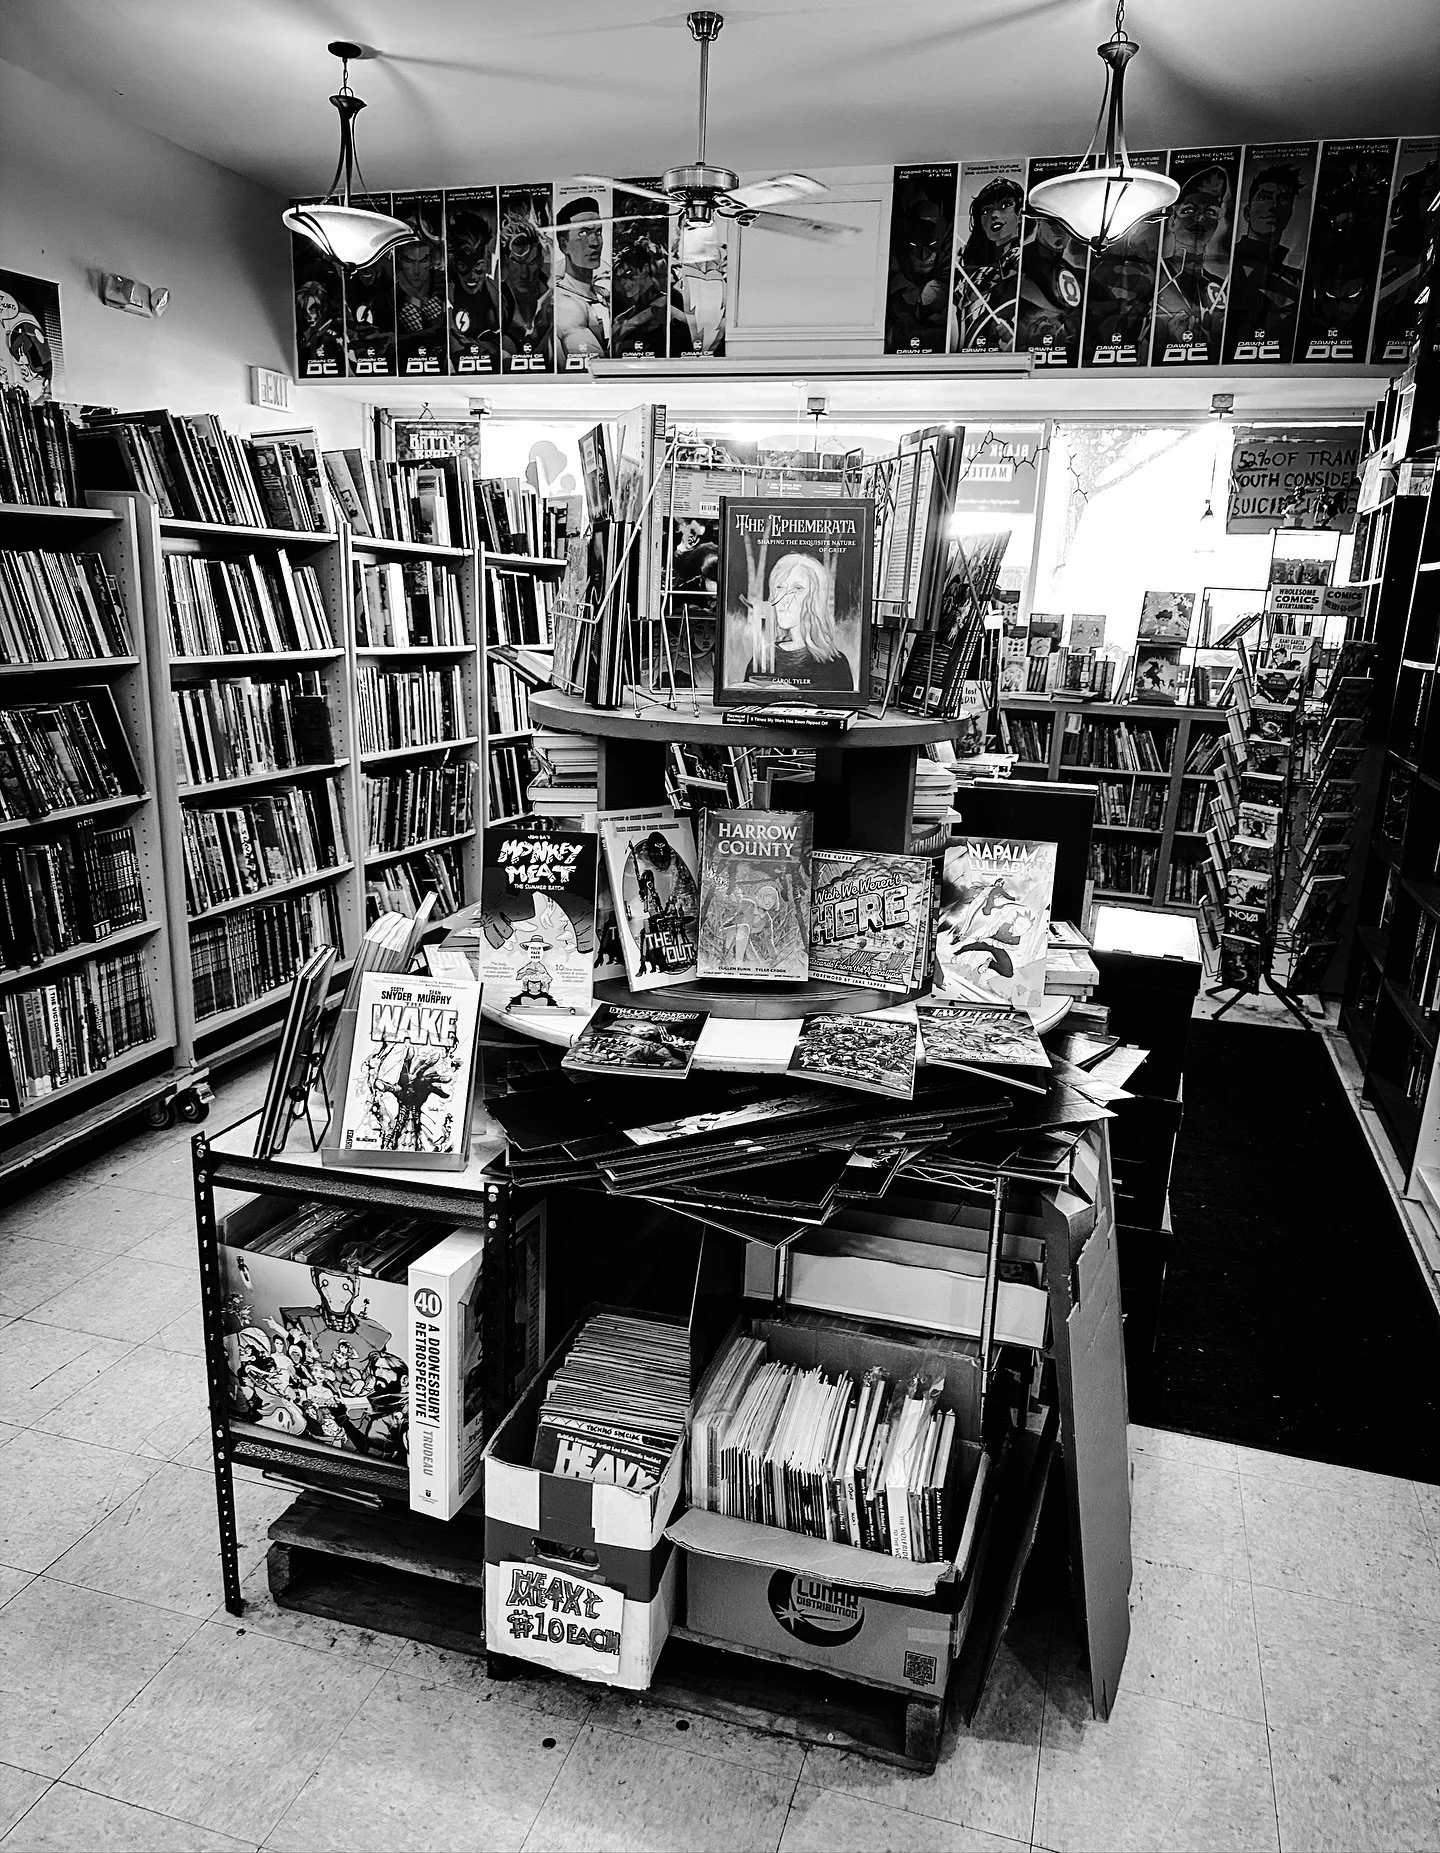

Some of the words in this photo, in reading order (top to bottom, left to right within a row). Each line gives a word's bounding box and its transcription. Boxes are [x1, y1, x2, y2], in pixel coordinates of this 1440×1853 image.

[1092, 350, 1137, 364] DC
[1162, 348, 1208, 362] DC
[1233, 345, 1281, 360] DC
[1305, 344, 1354, 359] DC
[1382, 346, 1412, 359] D
[306, 363, 339, 375] DC
[356, 362, 389, 374] DC
[406, 361, 440, 373] DC
[458, 360, 493, 372] DC
[510, 358, 546, 370] DC
[565, 357, 589, 370] D
[262, 374, 289, 408] EXIT
[654, 404, 666, 440] BOOM!
[1238, 448, 1271, 468] 52%
[1272, 451, 1299, 466] OF
[1306, 450, 1360, 467] TRAN
[1236, 474, 1280, 488] YOUTH
[736, 514, 765, 536] THE
[768, 514, 857, 537] EPHEMERATA
[757, 538, 784, 546] SHAPING
[785, 538, 798, 546] THE
[798, 539, 830, 547] EXQUISITE
[1274, 596, 1320, 604] COMICS
[1279, 588, 1317, 596] WHOLESOME
[1326, 590, 1363, 600] COMICS
[718, 822, 798, 841] HARROW
[497, 838, 584, 864] MONKEY
[718, 840, 795, 858] COUNTY
[966, 840, 1040, 864] NAPALM
[504, 862, 577, 884] MEAT
[967, 859, 1032, 874] LULLABY
[814, 888, 840, 905] Wish
[840, 882, 858, 898] We
[859, 873, 902, 894] Weren't
[810, 886, 910, 944] HERE
[1228, 909, 1258, 922] NOVA
[644, 931, 673, 950] THE
[812, 972, 842, 981] FOREWORD
[834, 960, 853, 970] from
[853, 965, 864, 973] the
[864, 966, 903, 979] Apocalypse
[381, 990, 412, 1002] SNYDER
[416, 993, 452, 1005] MURPHY
[370, 1004, 459, 1048] WAKE
[416, 1290, 440, 1315] 40
[428, 1324, 440, 1332] A
[415, 1322, 427, 1419] RETROSPECTIVE
[428, 1336, 440, 1424] DOONESBURY
[586, 1424, 613, 1435] TECHNO
[614, 1430, 640, 1440] SPECIAL
[422, 1431, 434, 1477] TRUDEAU
[556, 1432, 575, 1442] British
[574, 1438, 596, 1448] Fantasy
[595, 1442, 611, 1451] Artist
[620, 1448, 644, 1460] Edwards
[552, 1439, 657, 1492] HEAVY
[797, 1578, 859, 1610] LUNAR
[796, 1595, 858, 1620] DISTRIBUTION
[506, 1609, 565, 1644] $10
[566, 1623, 621, 1656] EACH
